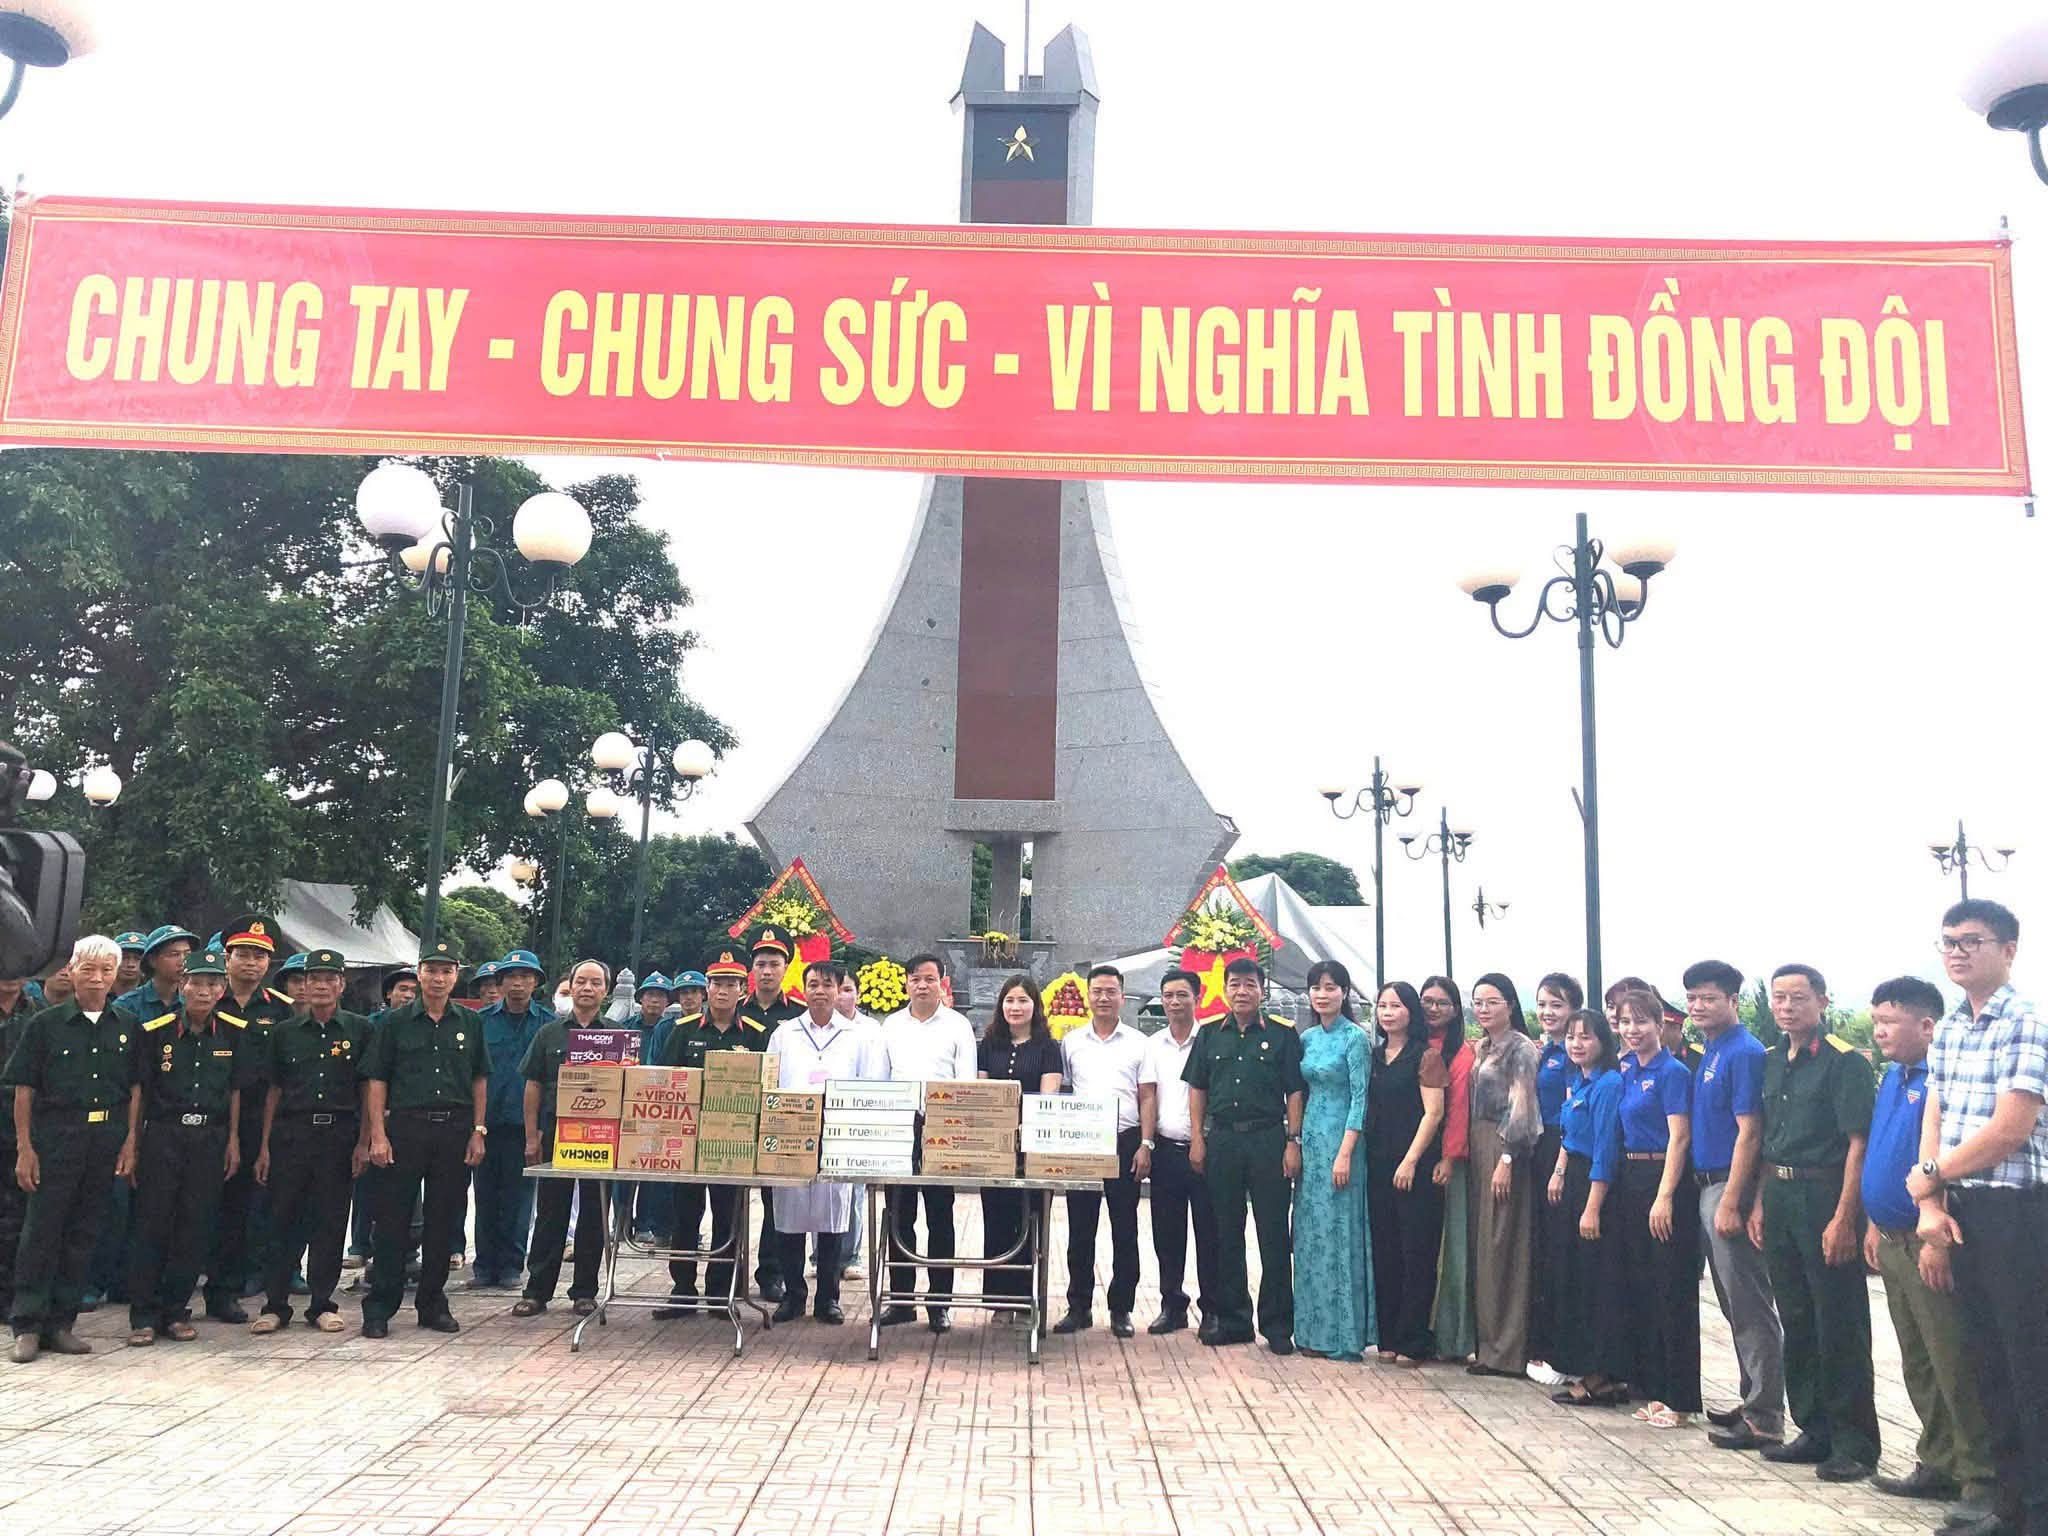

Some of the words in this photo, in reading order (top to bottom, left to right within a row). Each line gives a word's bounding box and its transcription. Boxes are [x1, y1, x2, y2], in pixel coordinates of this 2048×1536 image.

[66, 274, 324, 387] CHUNG
[350, 285, 469, 391] TAY
[489, 338, 515, 359] -
[540, 290, 795, 403] CHUNG
[820, 277, 967, 409] SỨC
[994, 353, 1019, 374] -
[1047, 281, 1112, 411] VÌ
[1139, 287, 1370, 416] NGHĨA
[1393, 287, 1564, 419] TÌNH
[1588, 277, 1797, 425] ĐỒNG
[1820, 295, 1950, 451] ĐỘI
[645, 1090, 687, 1101] VIFON
[766, 1095, 780, 1109] C2
[632, 1103, 692, 1121] VIFON
[764, 1137, 778, 1151] C2
[560, 1149, 609, 1160] BONCHA
[640, 1158, 681, 1169] VIFON
